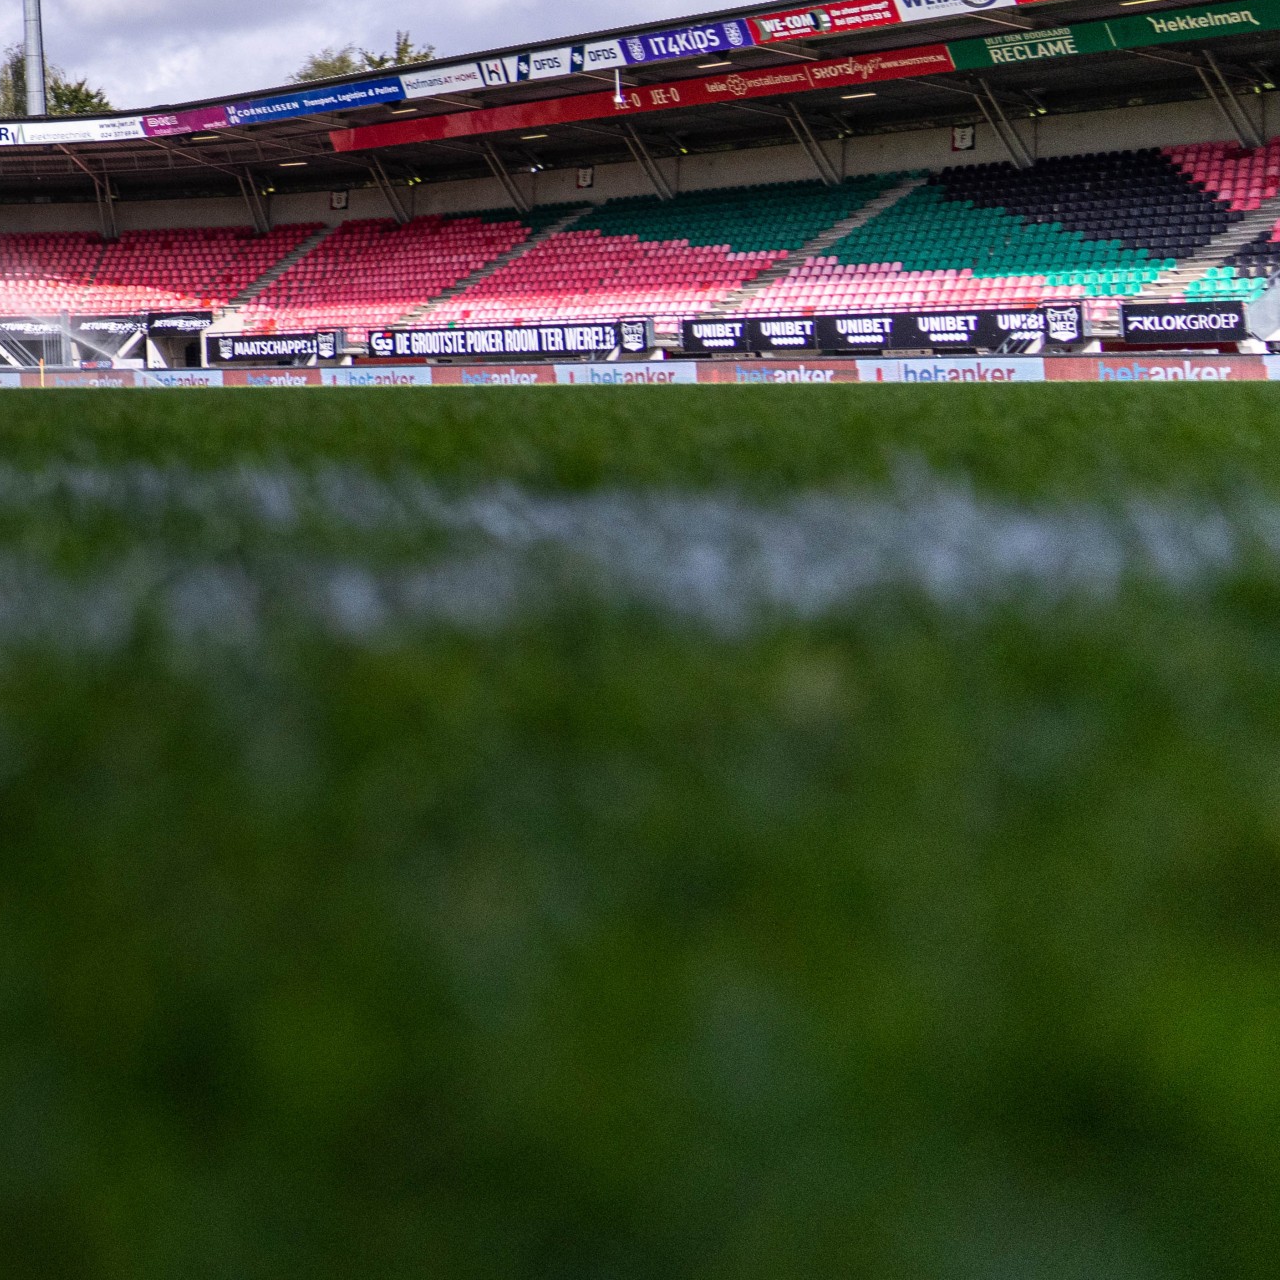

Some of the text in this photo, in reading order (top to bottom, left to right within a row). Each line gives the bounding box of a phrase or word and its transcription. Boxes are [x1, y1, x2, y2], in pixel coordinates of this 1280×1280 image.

[761, 13, 815, 32] WE-COM
[1147, 10, 1260, 33] Hekkelman
[589, 48, 617, 62] DFDS
[989, 39, 1079, 63] RECLAME
[533, 56, 561, 70] DFDS
[237, 102, 300, 118] CORNELISSEN
[760, 320, 814, 337] UNIBET
[835, 318, 892, 334] UNIBET
[917, 315, 978, 332] UNIBET
[1143, 313, 1239, 331] KLOKGROEP
[692, 323, 743, 339] UNIBET
[395, 332, 411, 355] DE
[411, 330, 465, 354] GROOTSTE
[466, 329, 503, 353] POKER
[505, 328, 539, 352] ROOM
[540, 327, 563, 351] TER
